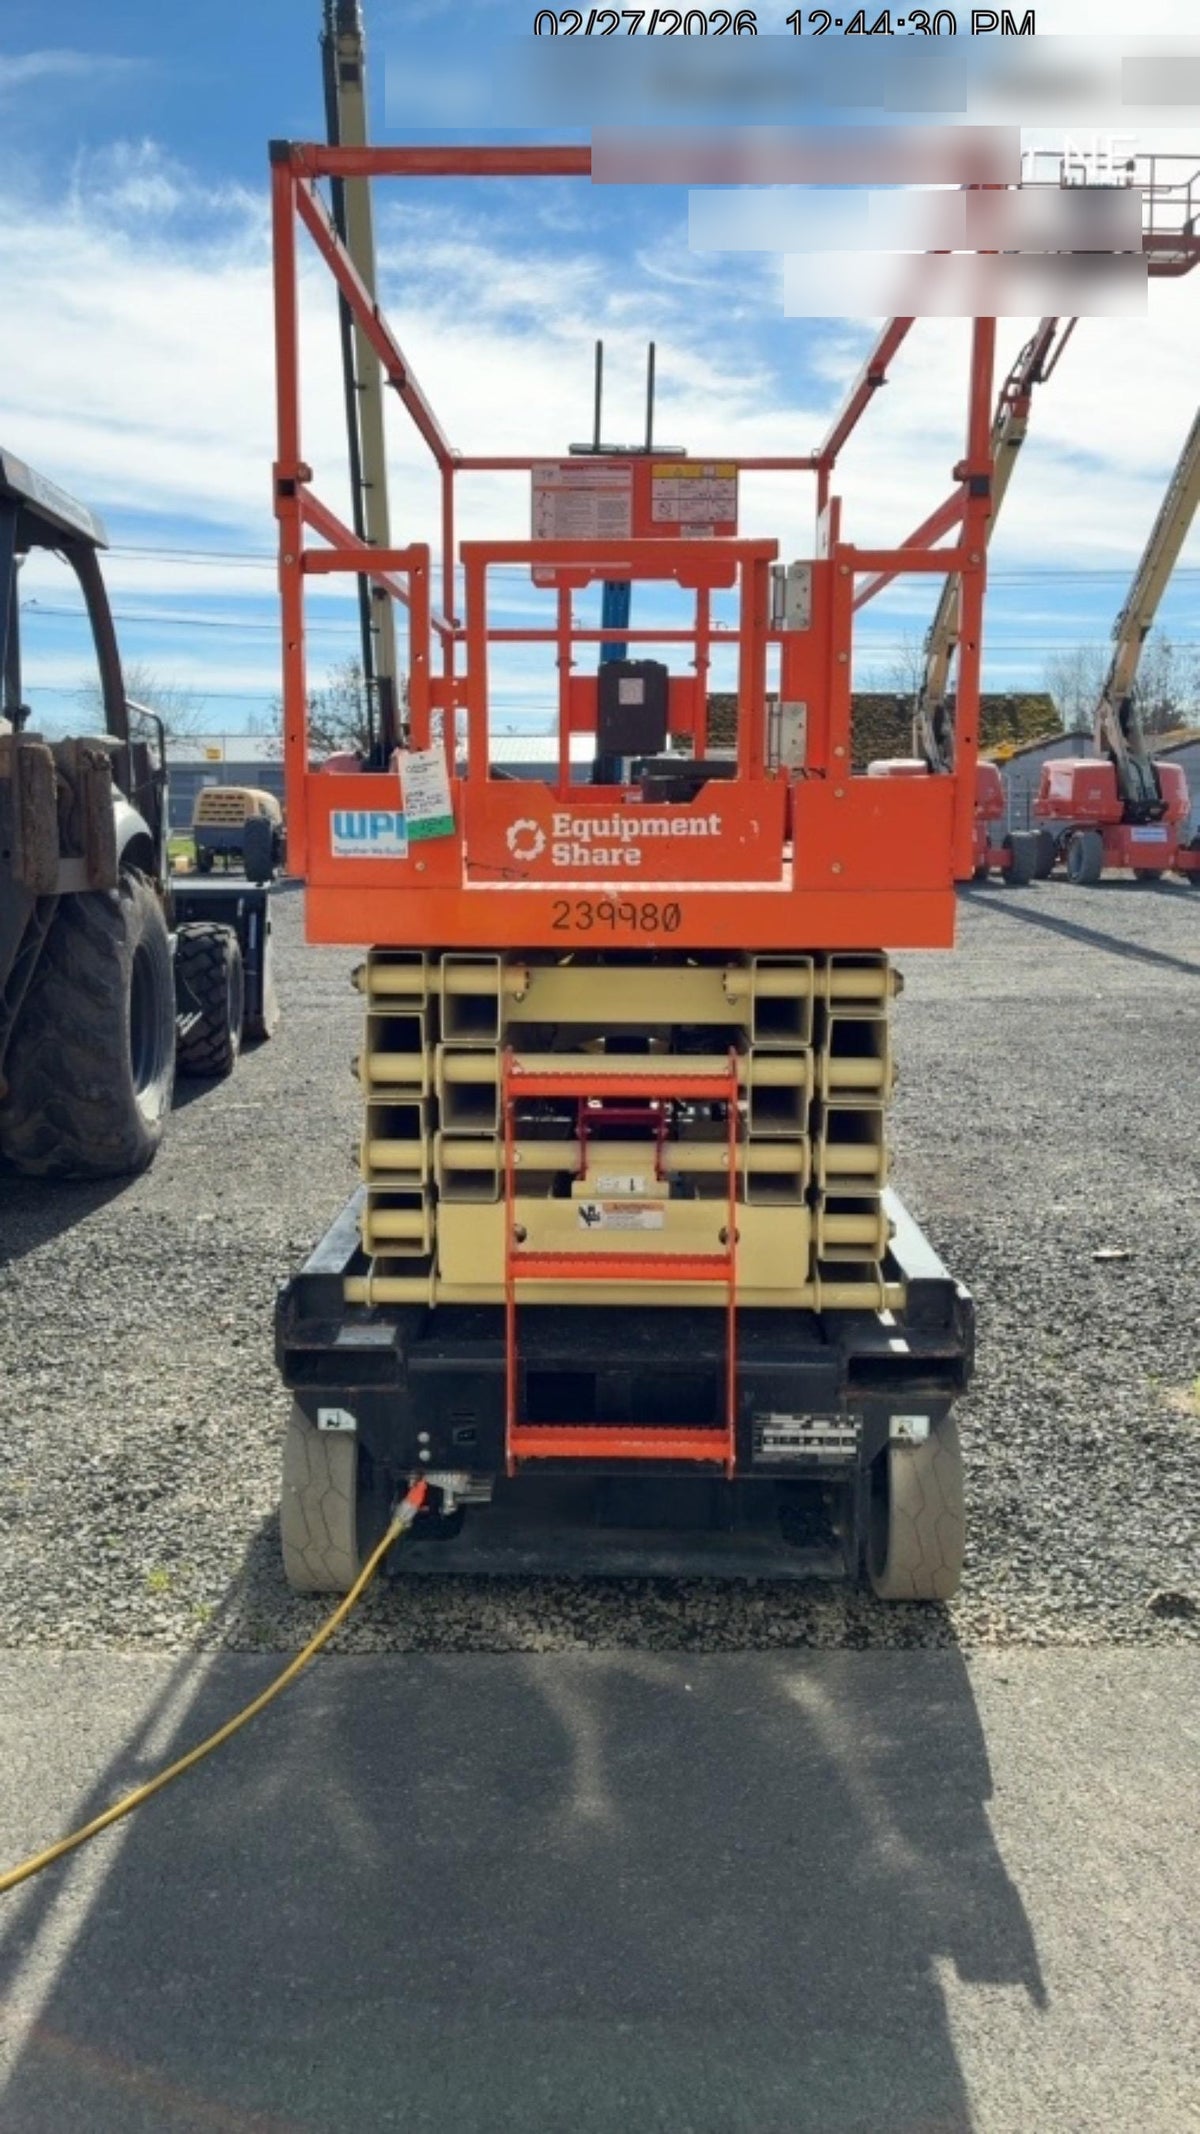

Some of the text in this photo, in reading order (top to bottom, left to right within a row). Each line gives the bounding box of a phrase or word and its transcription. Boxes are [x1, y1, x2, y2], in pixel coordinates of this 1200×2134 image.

[334, 812, 405, 840] WPI
[551, 812, 722, 842] Equipment
[551, 842, 642, 866] Share
[551, 900, 682, 932] 239980
